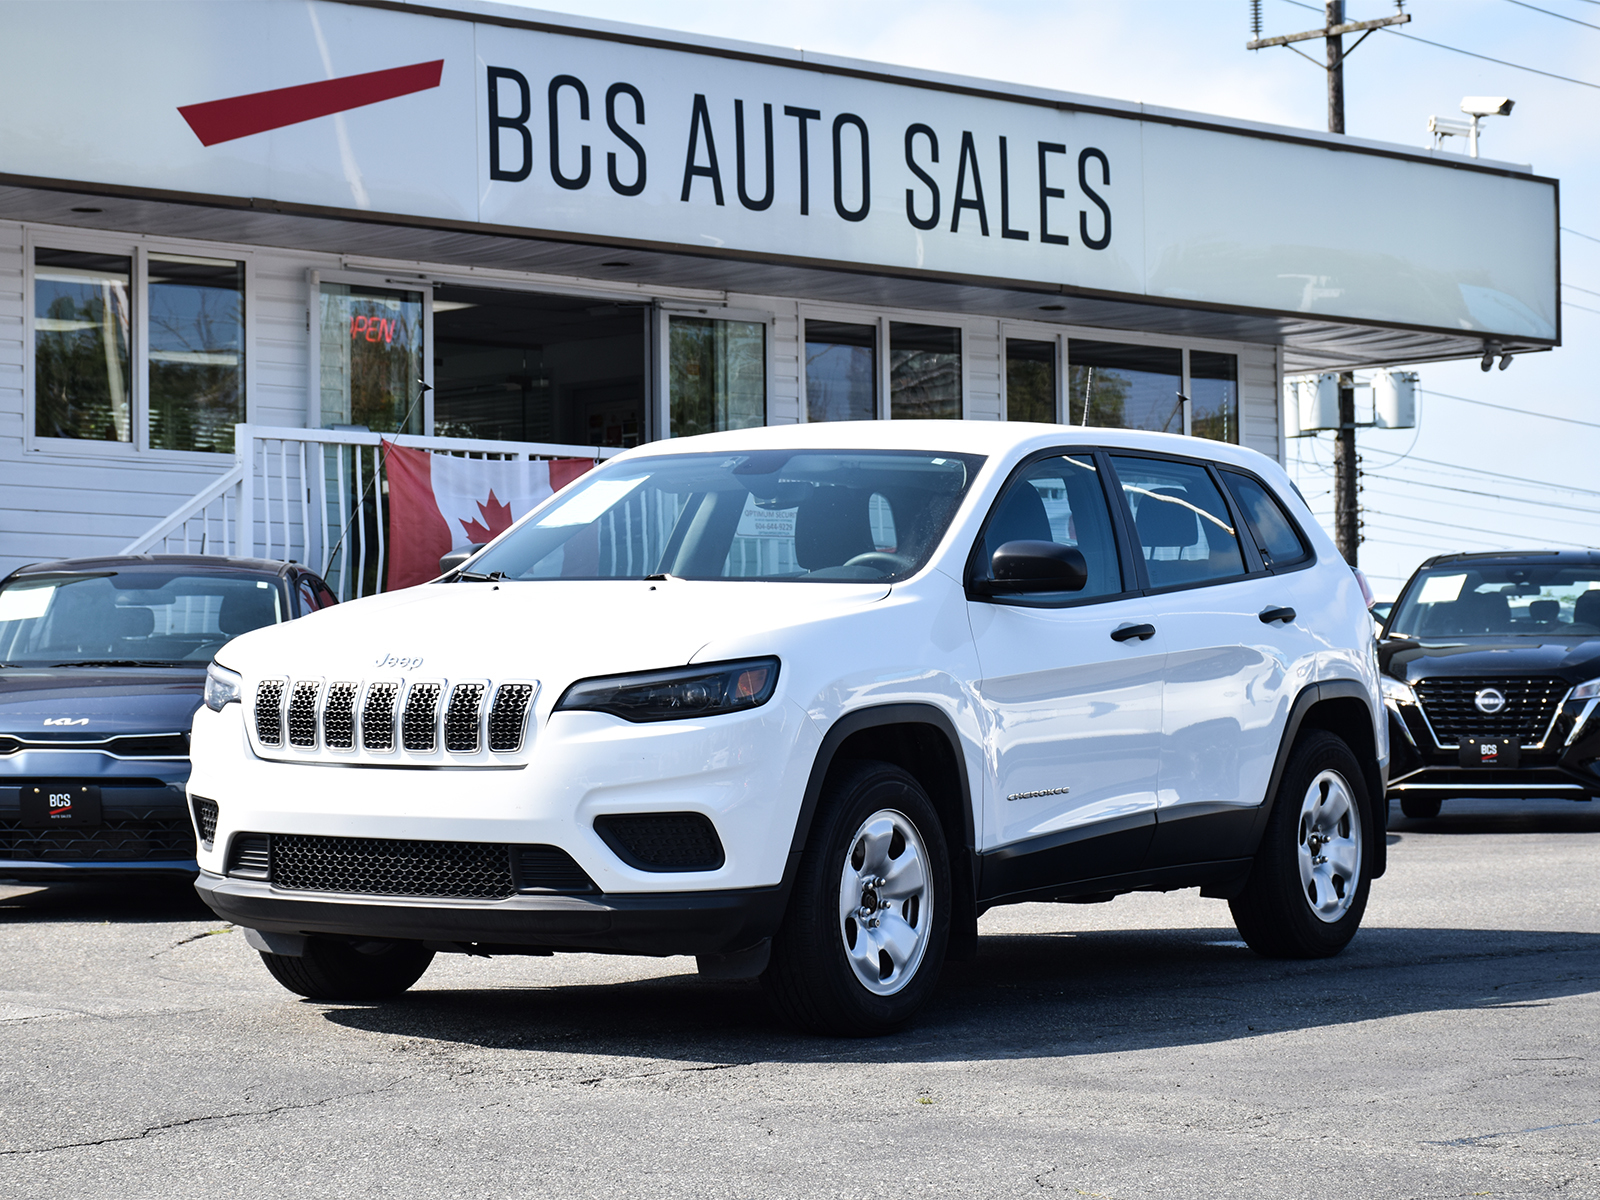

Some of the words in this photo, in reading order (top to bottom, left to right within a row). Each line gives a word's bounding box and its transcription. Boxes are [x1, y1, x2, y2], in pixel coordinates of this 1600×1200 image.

[486, 65, 648, 197] BCS
[680, 93, 871, 223] AUTO
[904, 122, 1113, 251] SALES
[745, 510, 774, 518] OPTIMUM
[375, 652, 424, 671] Jeep
[1481, 744, 1497, 754] BCS
[49, 793, 71, 807] BCS
[1006, 786, 1070, 801] CHEROKEE
